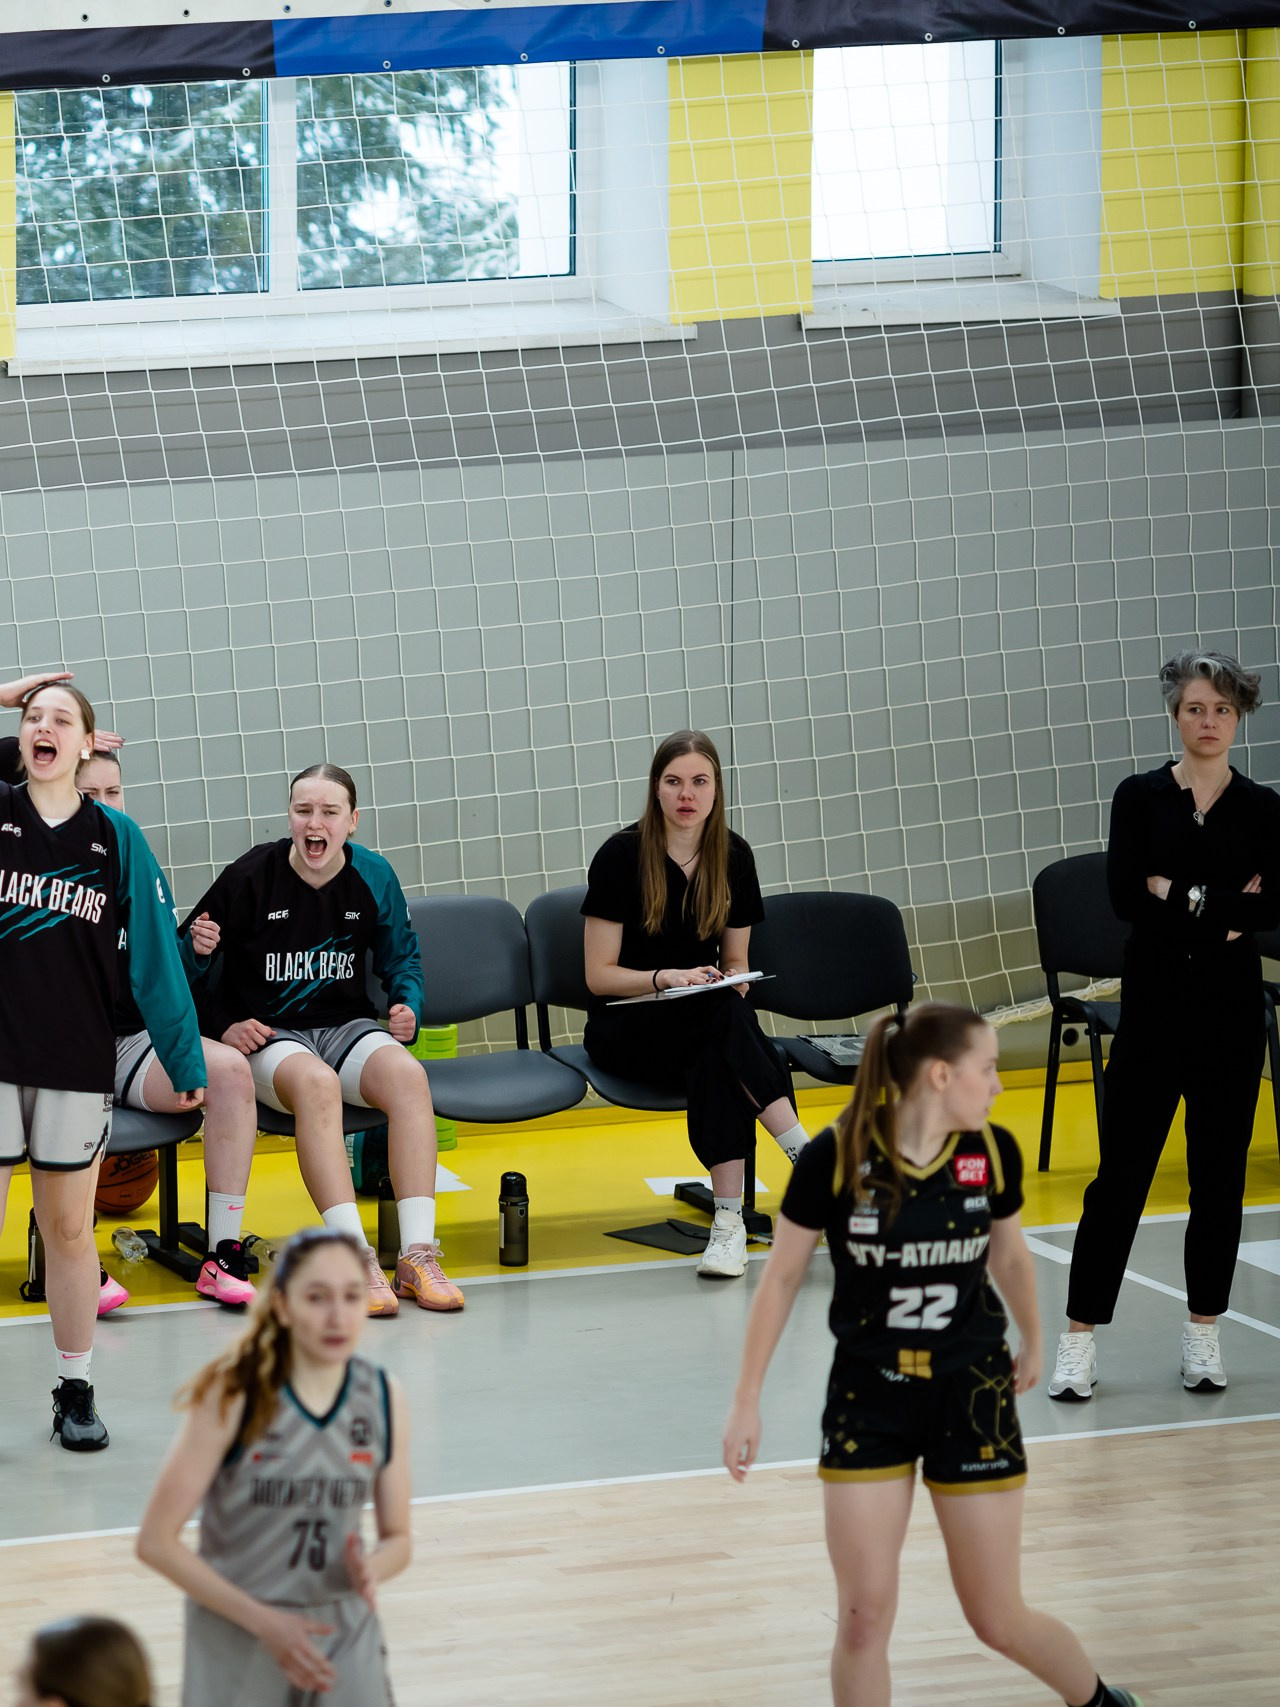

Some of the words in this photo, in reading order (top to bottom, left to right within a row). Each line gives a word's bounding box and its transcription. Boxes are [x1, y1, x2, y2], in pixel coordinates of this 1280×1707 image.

[47, 878, 107, 925] BEARS
[344, 911, 361, 921] STK
[265, 951, 315, 982] BLACK
[956, 1157, 987, 1171] FON
[957, 1170, 987, 1183] BET
[887, 1284, 958, 1330] 22
[288, 1518, 328, 1573] 75
